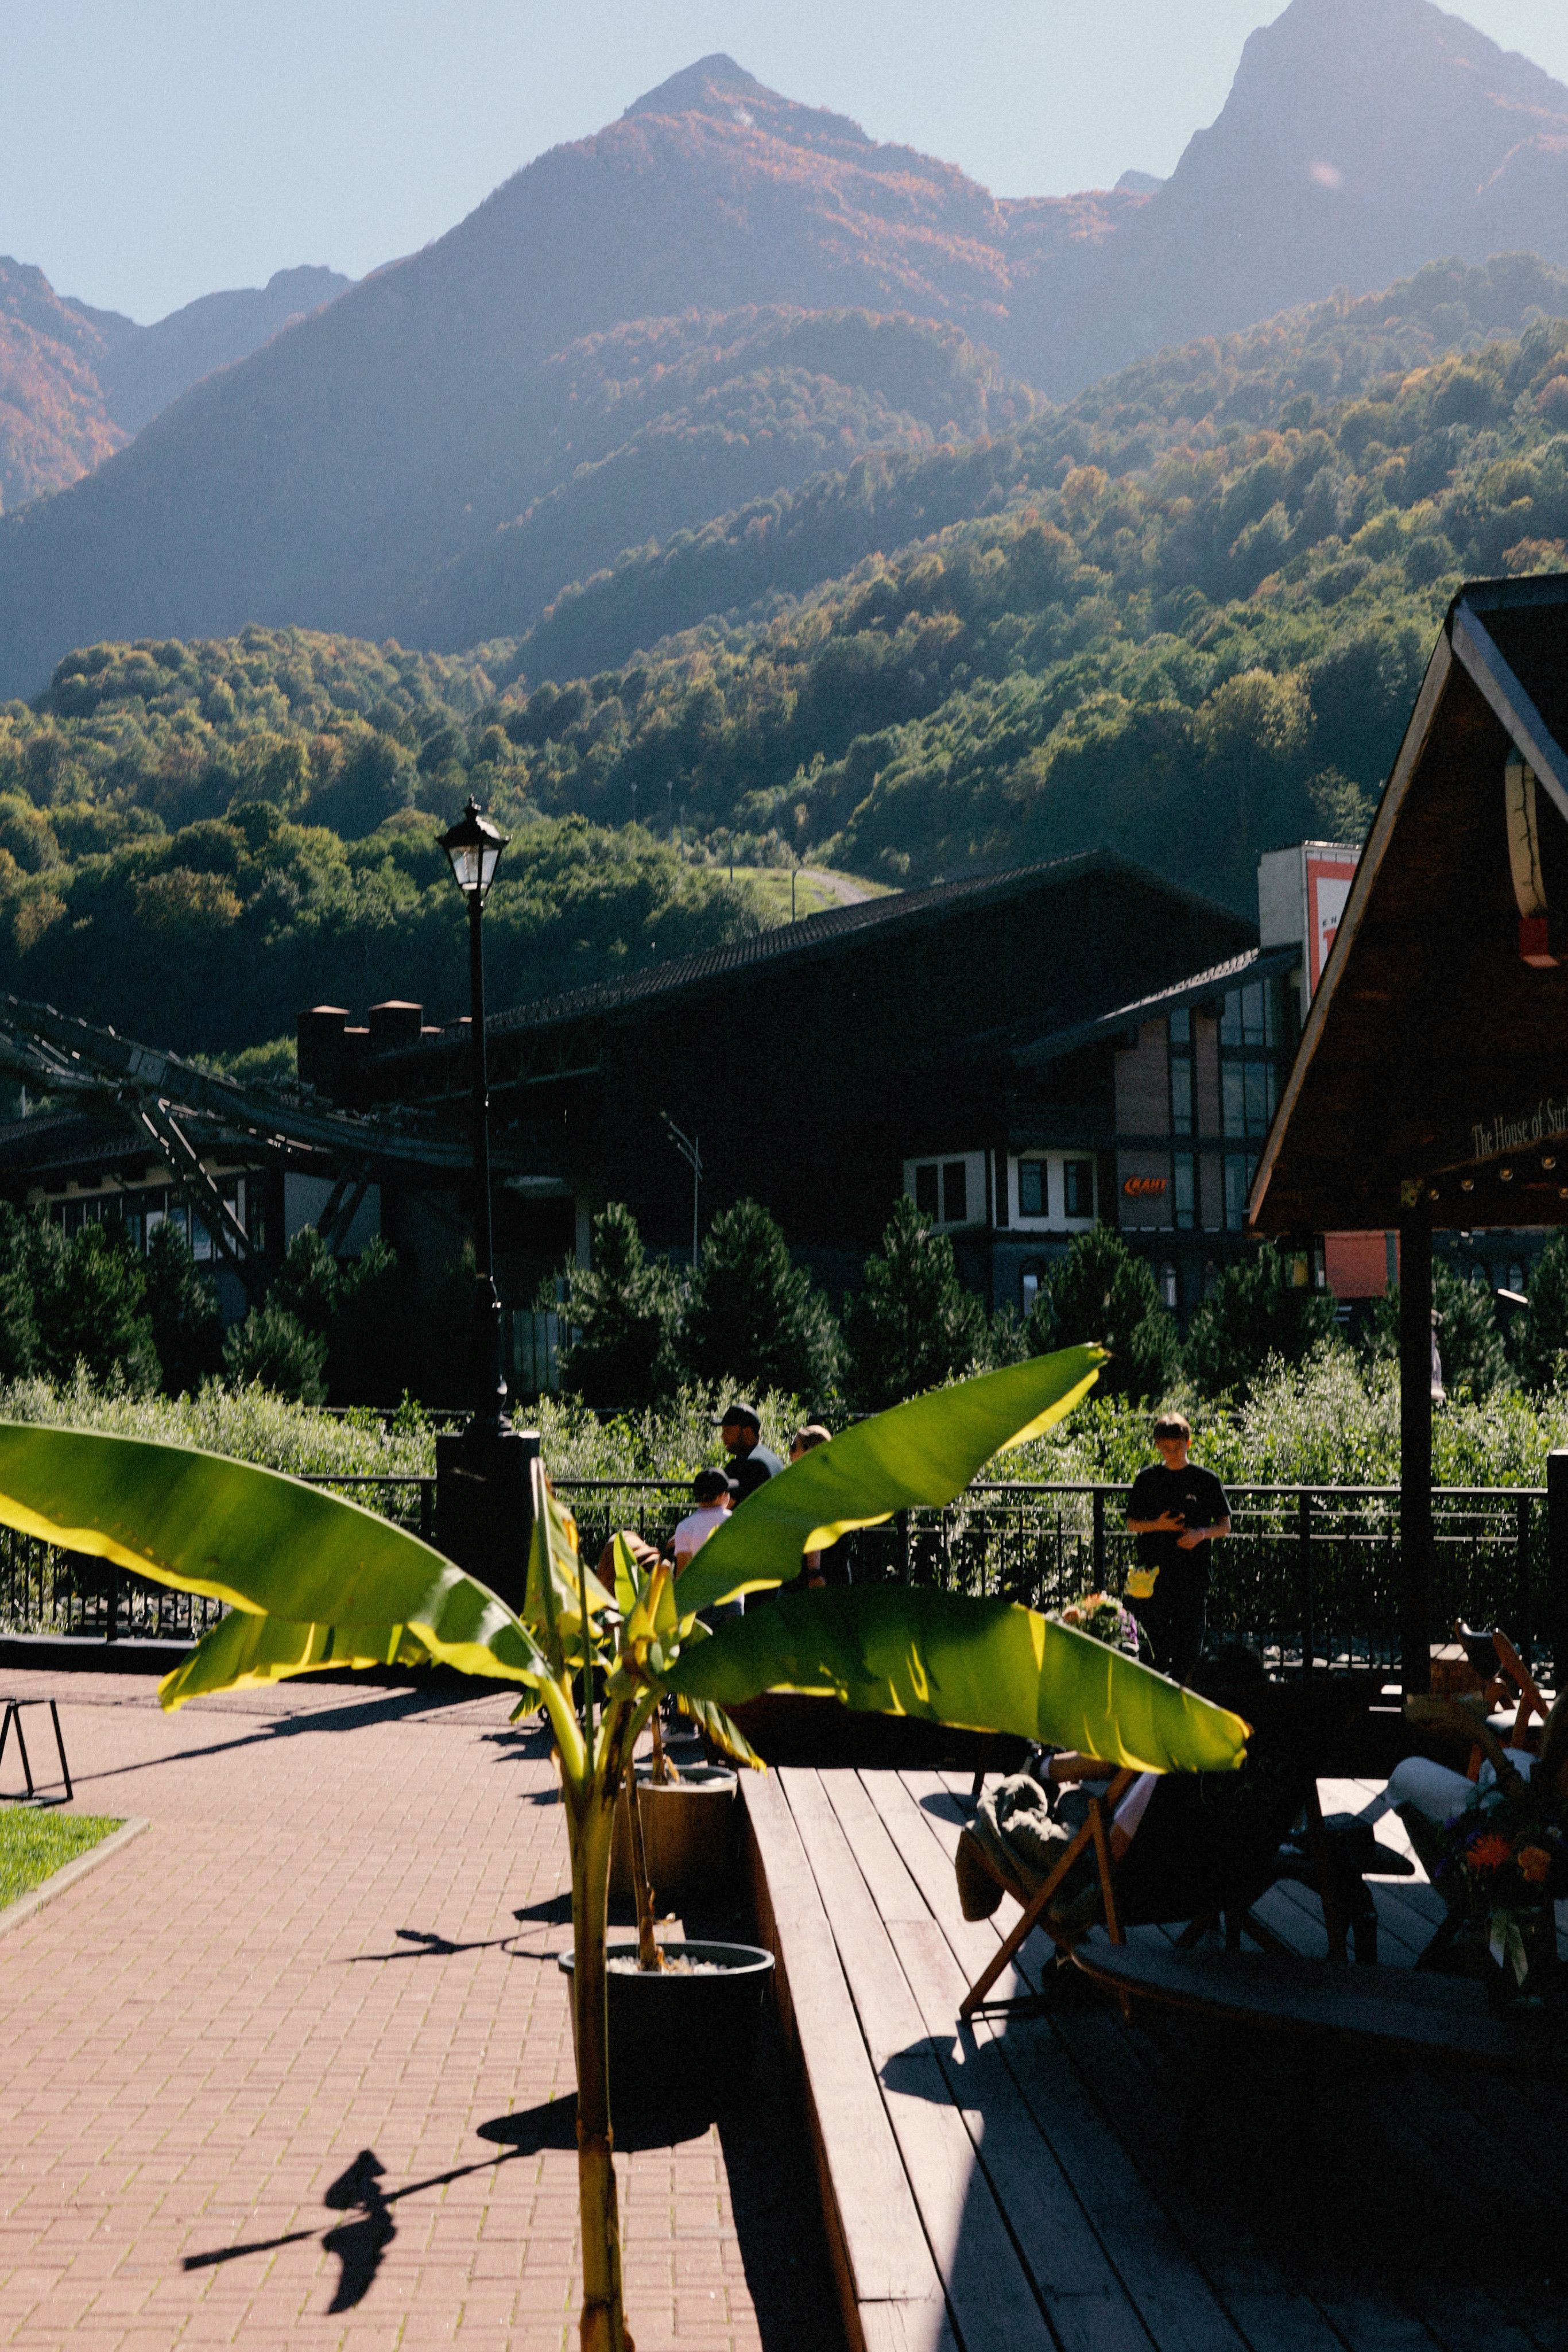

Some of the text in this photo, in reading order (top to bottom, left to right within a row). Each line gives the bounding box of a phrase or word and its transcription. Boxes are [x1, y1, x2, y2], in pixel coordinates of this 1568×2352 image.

[1472, 1096, 1568, 1158] The House of Sur
